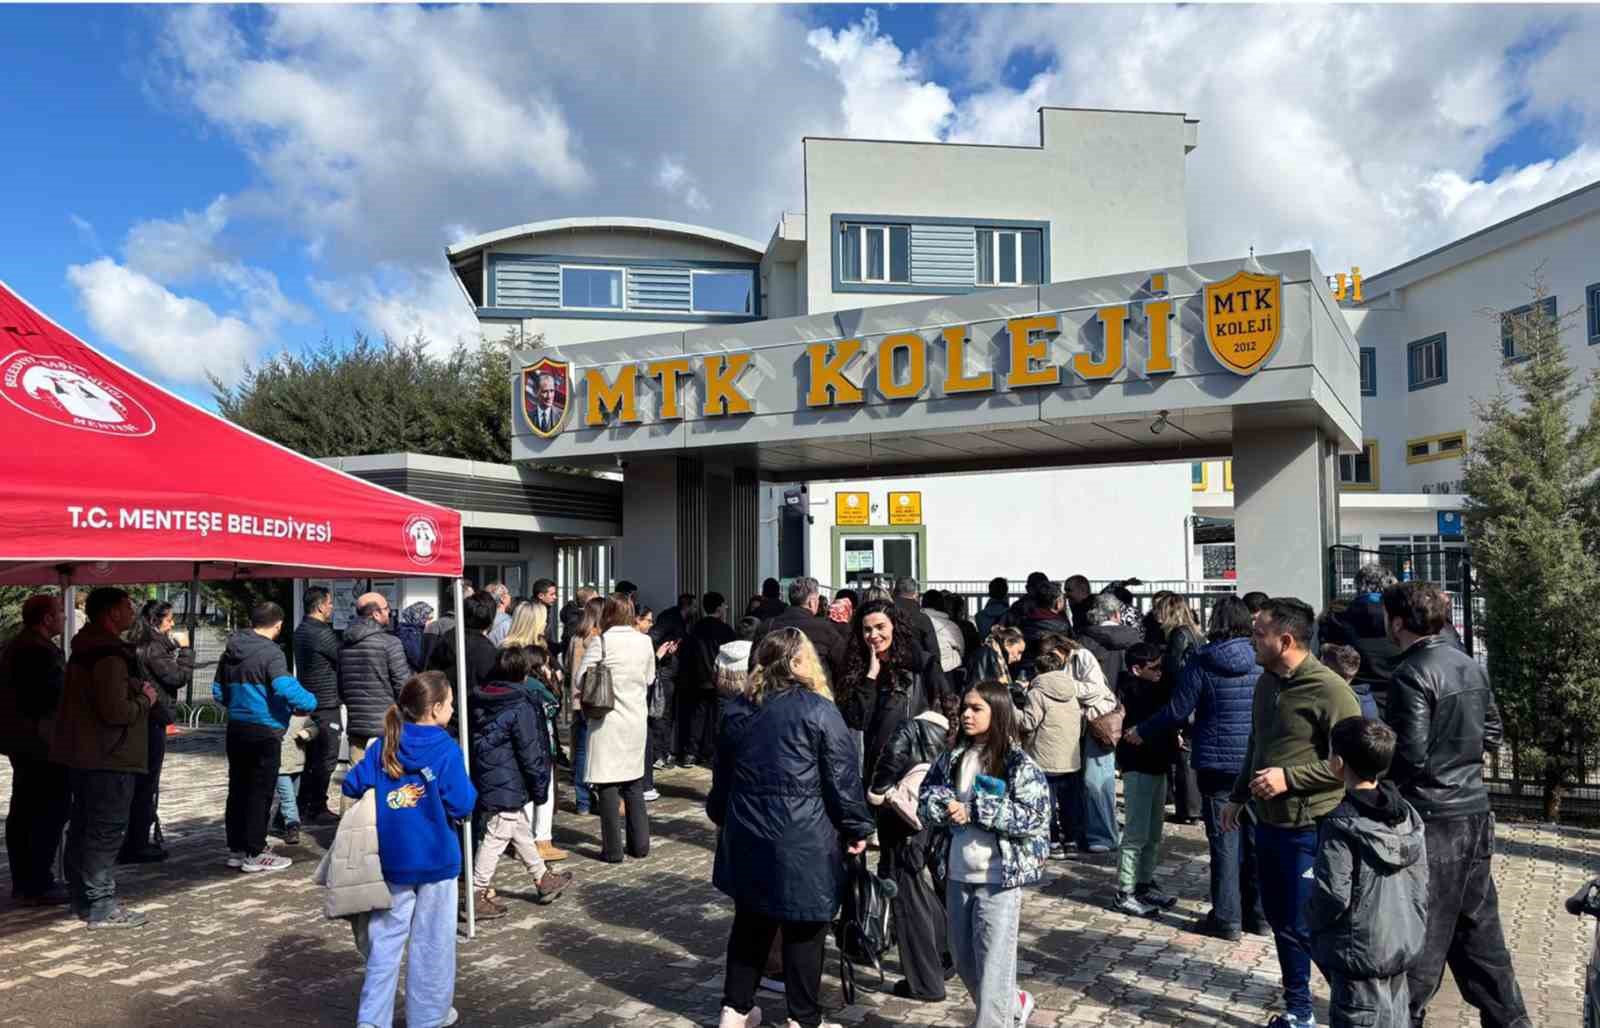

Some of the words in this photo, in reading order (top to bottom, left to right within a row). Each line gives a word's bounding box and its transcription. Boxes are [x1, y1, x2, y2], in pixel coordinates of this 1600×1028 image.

[1213, 288, 1273, 315] MTK
[1216, 314, 1272, 337] KOLEJİ
[585, 353, 754, 427] MTK
[806, 274, 1177, 405] KOLEJİ
[1233, 341, 1257, 353] 2012
[68, 506, 113, 528] T.C.
[119, 508, 223, 536] MENTEŞE
[227, 514, 332, 543] BELEDİYESİ
